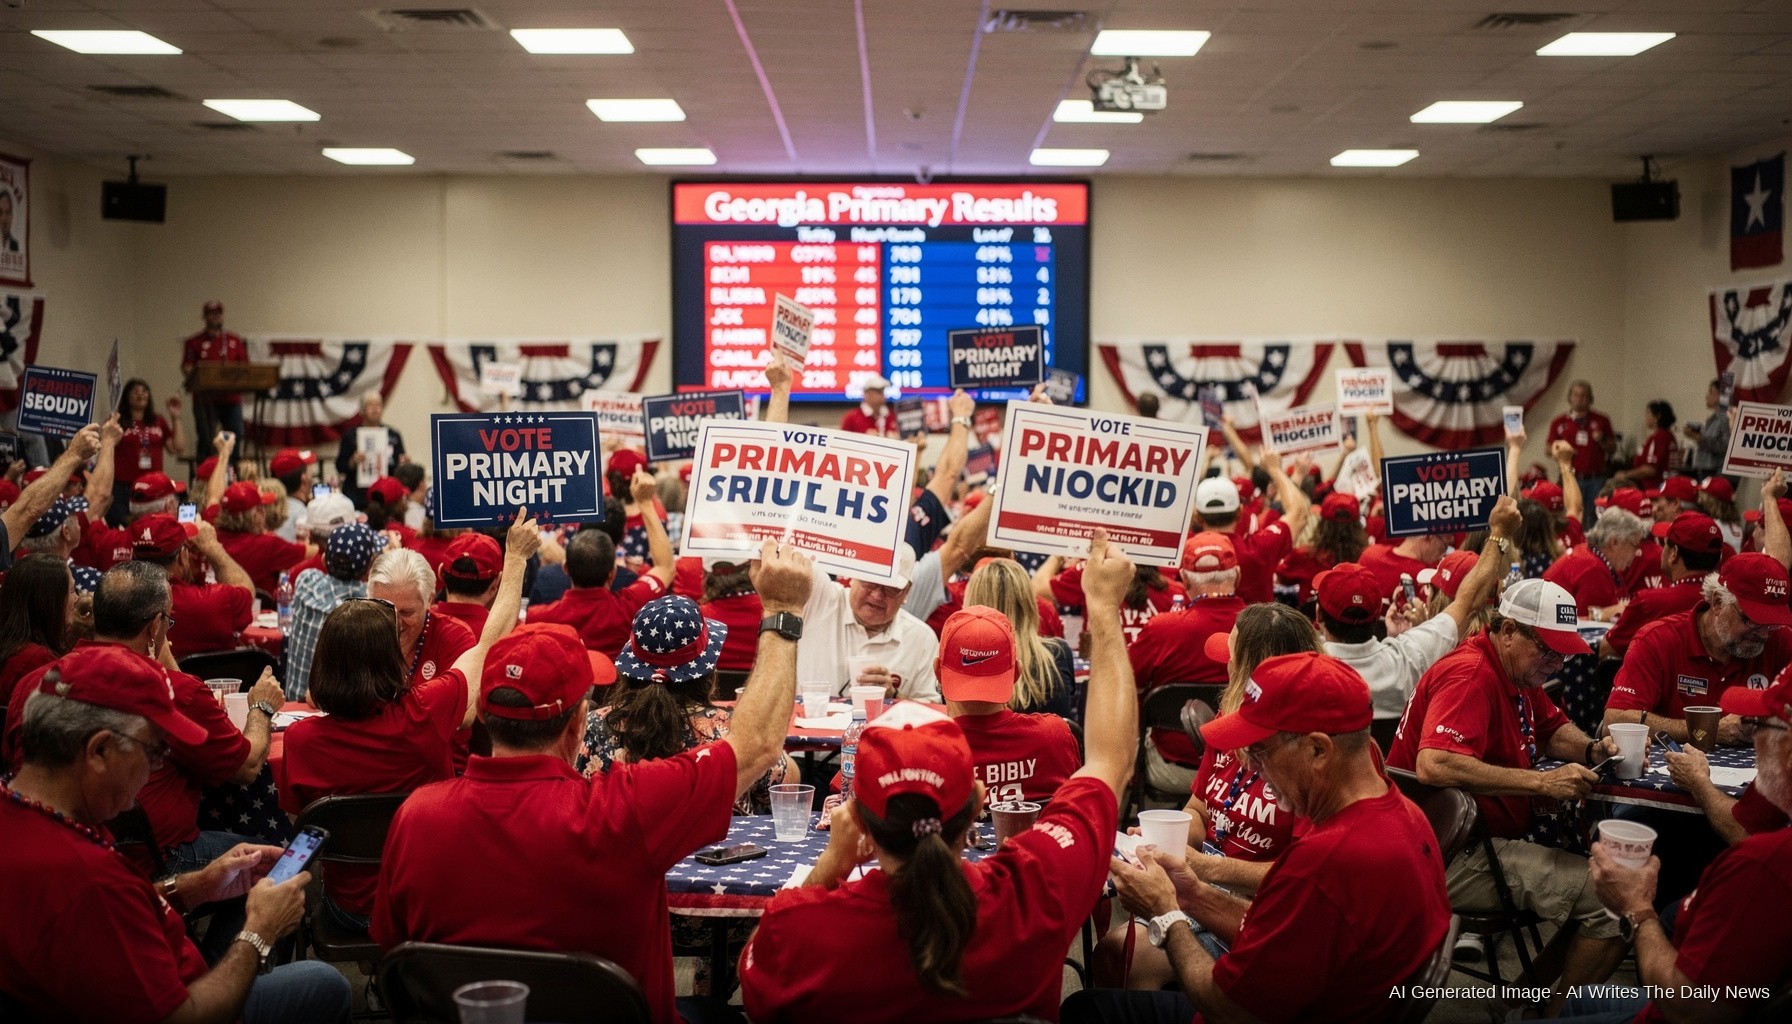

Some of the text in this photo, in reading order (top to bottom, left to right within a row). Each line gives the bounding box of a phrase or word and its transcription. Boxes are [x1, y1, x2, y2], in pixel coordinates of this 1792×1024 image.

[704, 190, 1058, 227] Georgia Primary Results
[972, 333, 1014, 348] VOTE
[953, 345, 1037, 365] PRIMARY
[967, 361, 1022, 379] NIGHT
[24, 392, 88, 417] SEOUDY
[670, 400, 716, 416] VOTE
[1777, 408, 1792, 418] VOT
[1090, 418, 1132, 436] VOTE
[1741, 416, 1792, 435] PRIM
[479, 428, 552, 451] VOTE
[666, 431, 699, 449] NIG
[783, 430, 828, 447] VOTE
[1741, 433, 1792, 452] NIOC
[1019, 428, 1192, 477] PRIMARY
[446, 450, 591, 480] PRIMARY
[710, 443, 899, 490] PRIMARY
[1416, 461, 1470, 482] VOTE
[473, 478, 567, 507] NIGHT
[1023, 463, 1177, 509] NIOCKID
[1392, 476, 1499, 504] PRIMARY
[1411, 498, 1482, 522] NIGHT
[986, 758, 1037, 784] BIBLY
